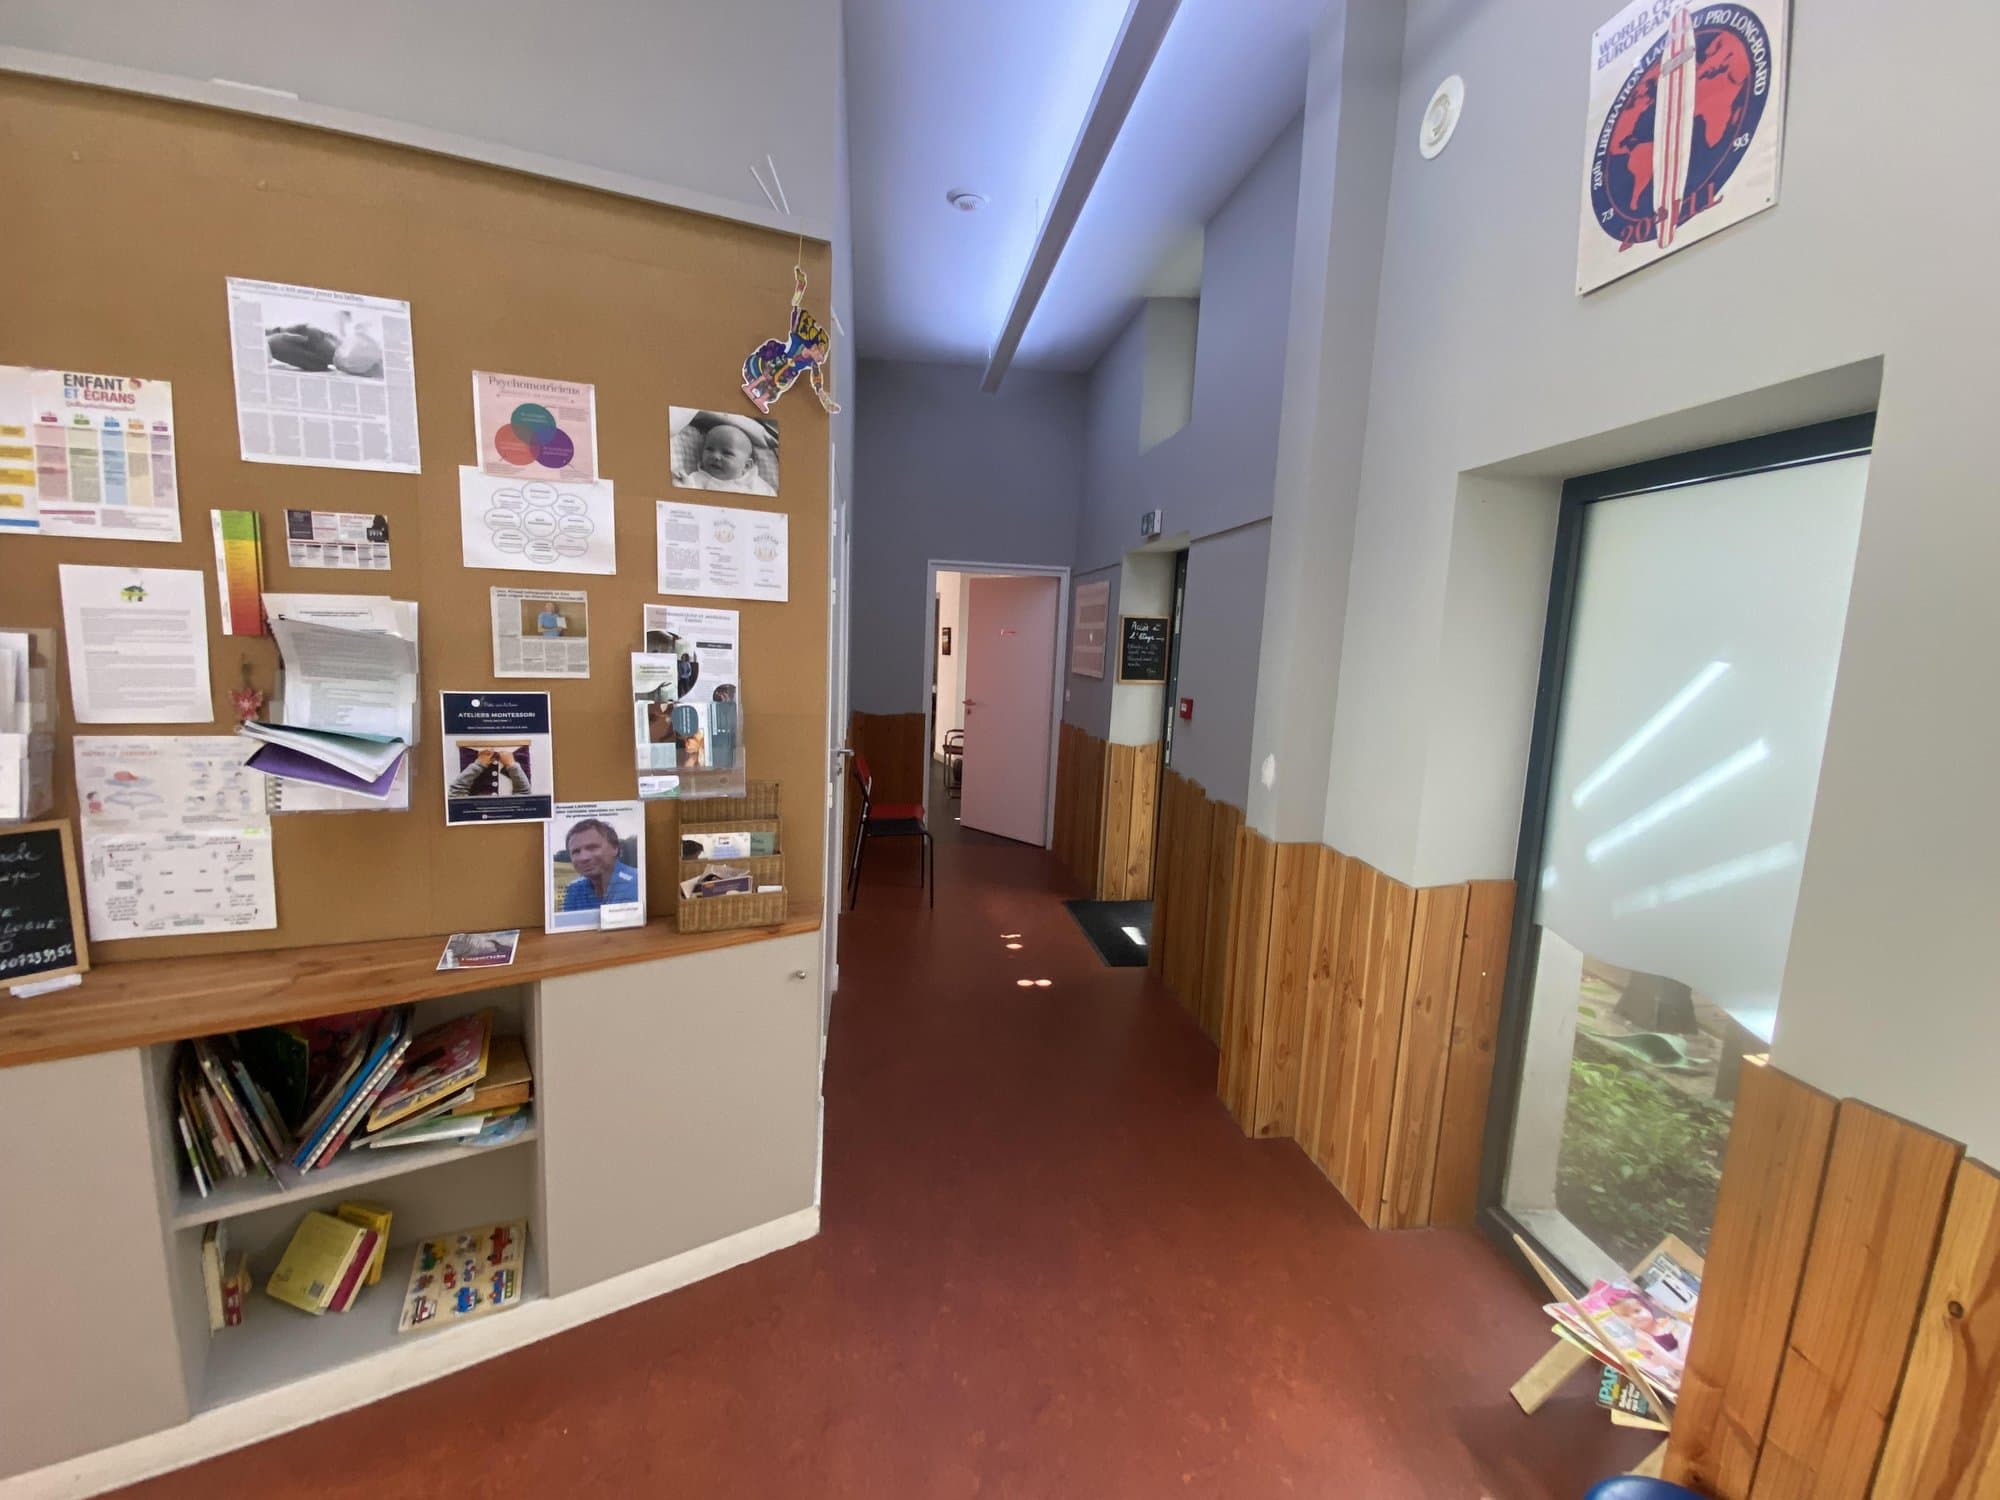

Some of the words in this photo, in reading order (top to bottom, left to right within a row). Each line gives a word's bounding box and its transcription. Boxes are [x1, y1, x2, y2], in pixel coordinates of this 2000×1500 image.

[1598, 10, 1669, 70] EUROPEAN
[1600, 11, 1648, 55] WORLD
[1597, 66, 1645, 157] LIBERATION
[1704, 9, 1732, 25] PRO
[63, 373, 125, 391] ENFANT
[64, 388, 79, 399] ET
[488, 375, 580, 396] Psychomotriciens
